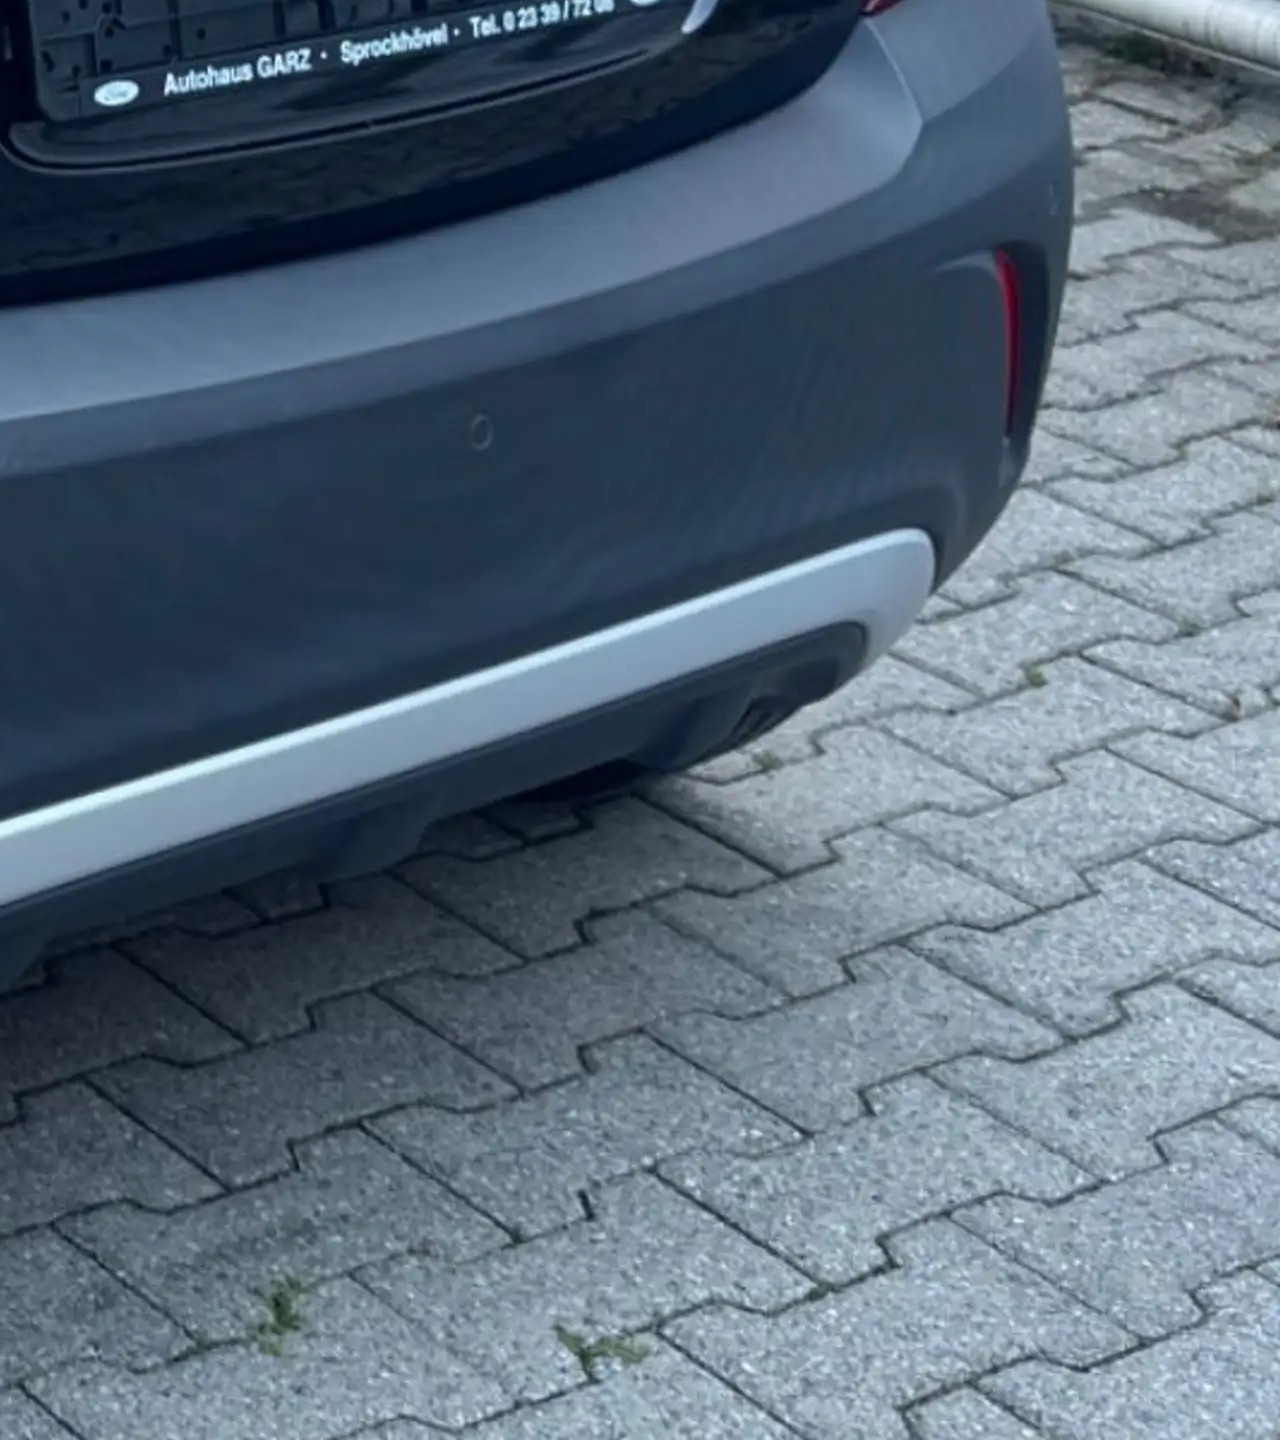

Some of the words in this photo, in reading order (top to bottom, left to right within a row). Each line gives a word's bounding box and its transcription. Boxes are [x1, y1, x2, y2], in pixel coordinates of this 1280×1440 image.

[163, 63, 254, 96] Autohaus
[256, 47, 313, 78] GARZ
[468, 13, 501, 39] Tel.
